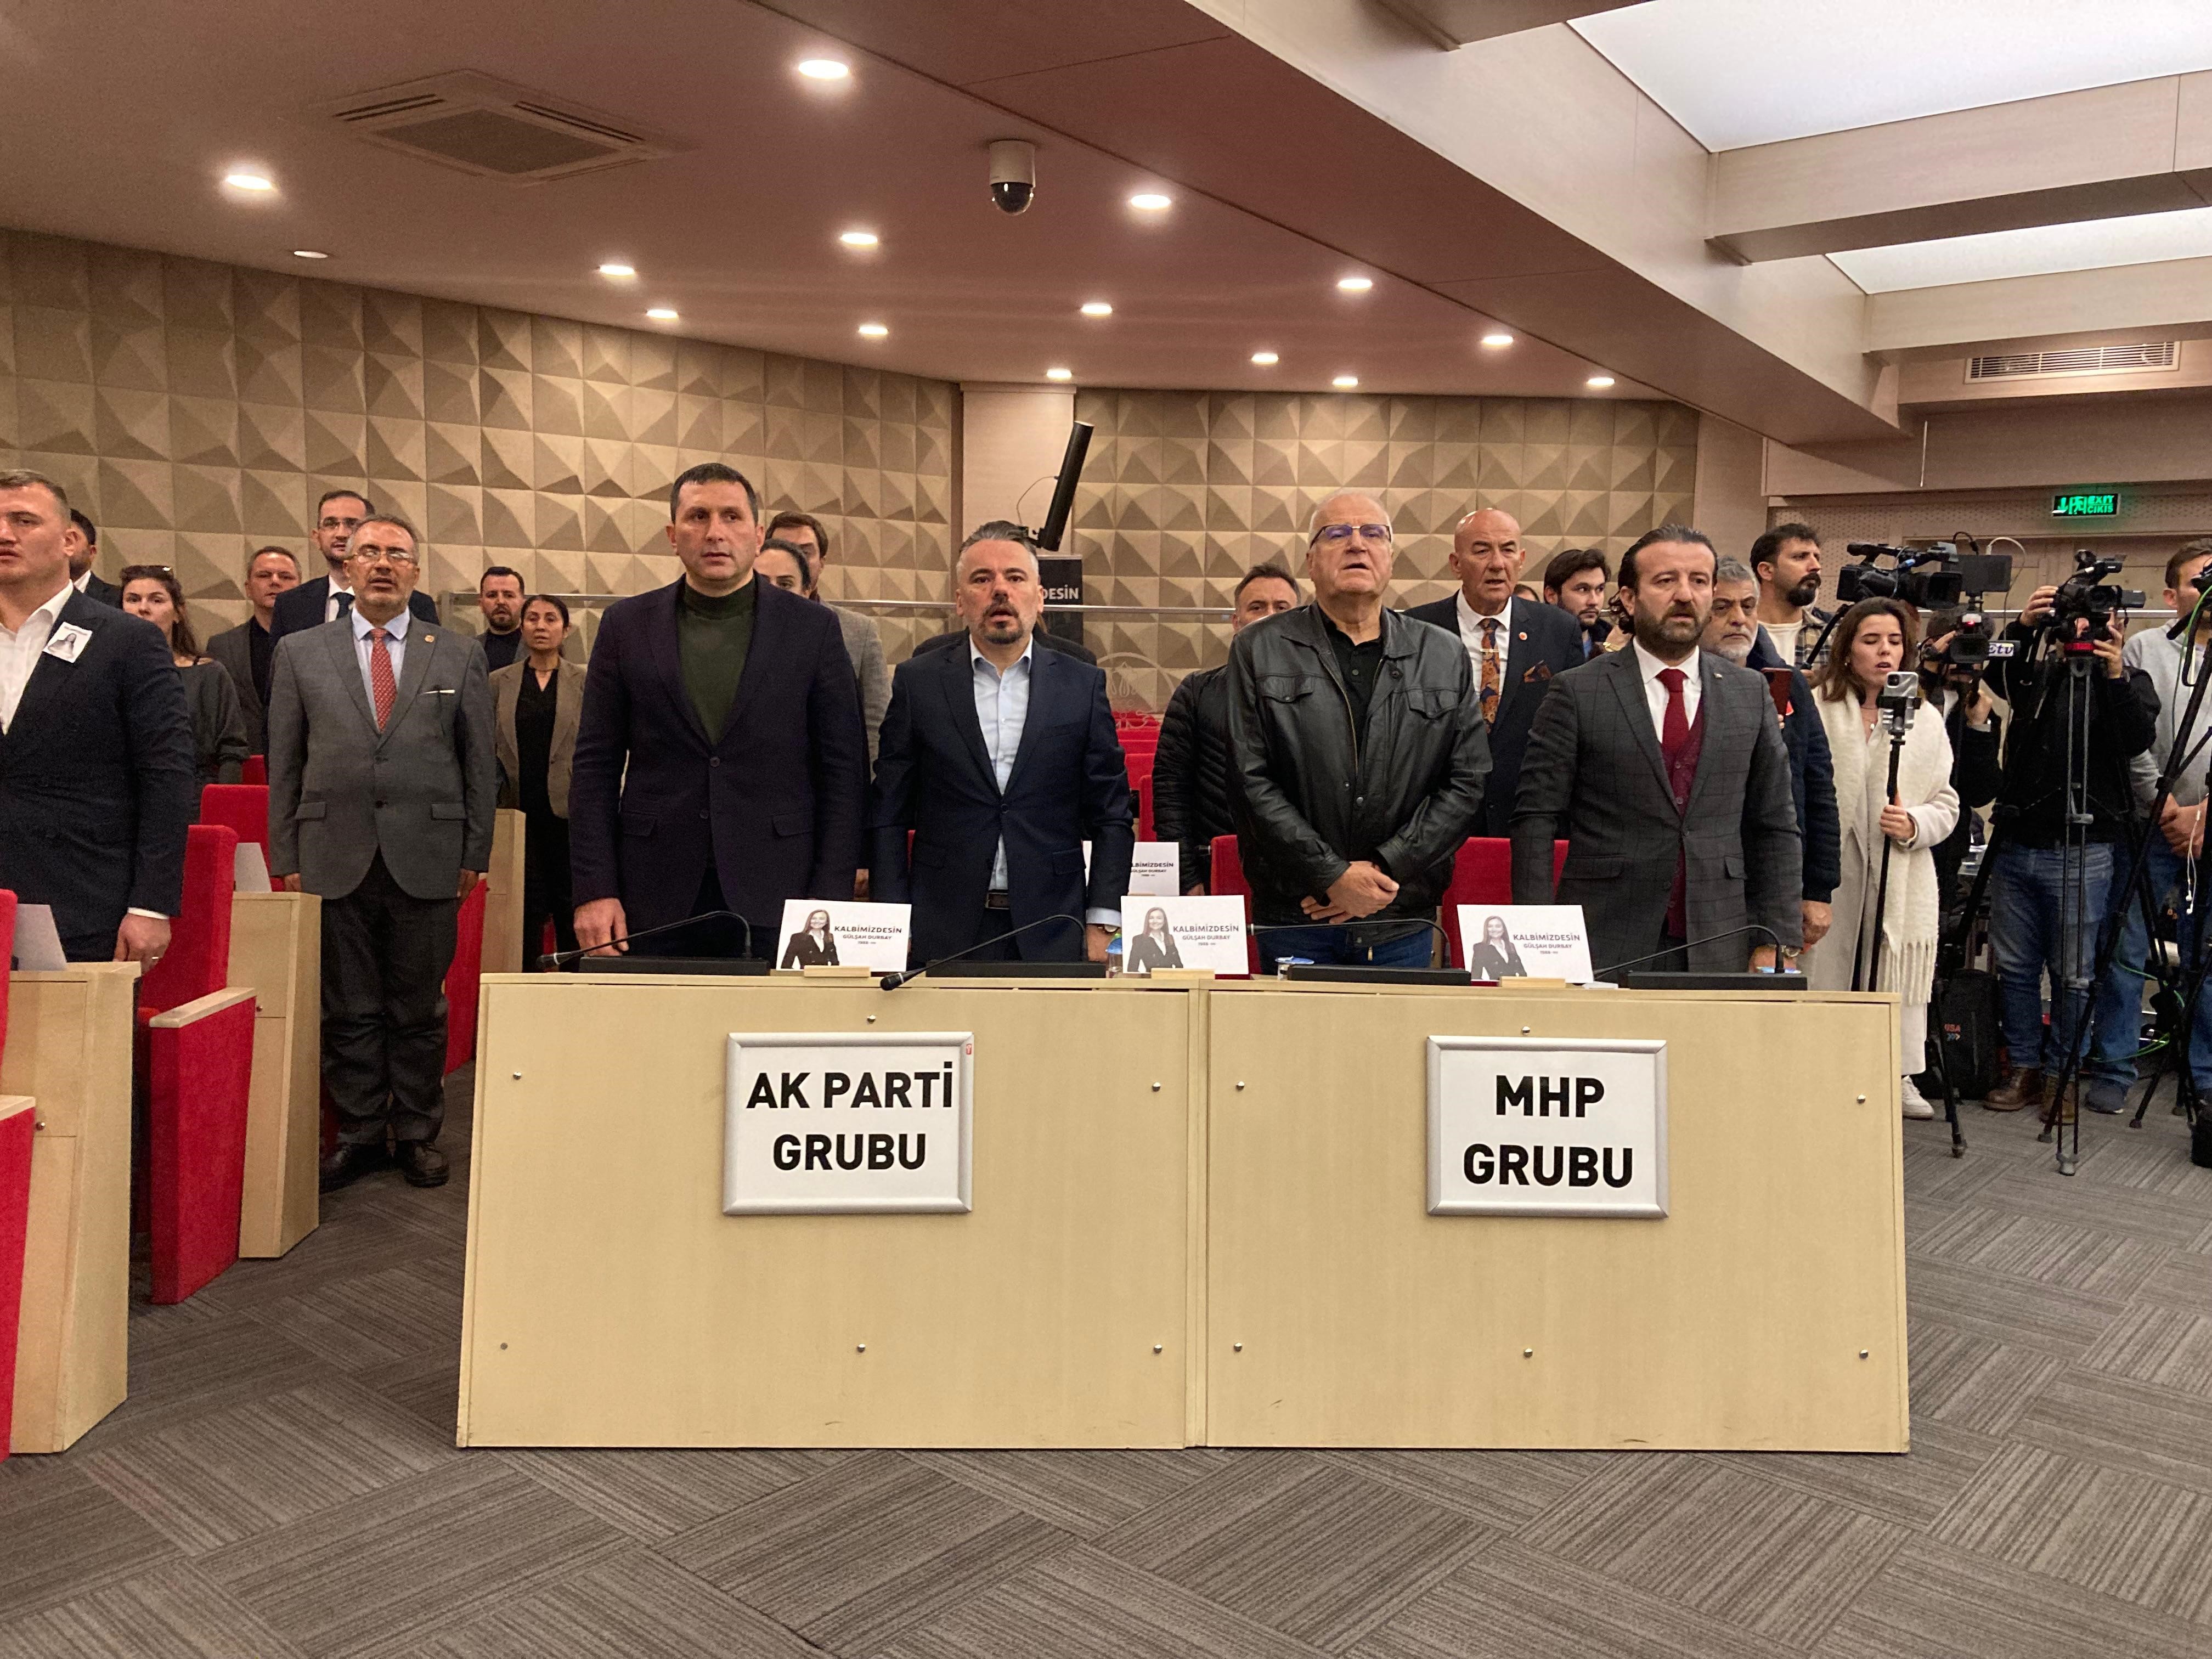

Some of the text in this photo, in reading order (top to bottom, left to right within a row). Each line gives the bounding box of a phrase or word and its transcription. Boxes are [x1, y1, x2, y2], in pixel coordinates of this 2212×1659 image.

[2088, 495, 2114, 504] EXIT
[834, 925, 902, 933] KALBİMİZDESİN
[1173, 923, 1239, 932] KALBİMİZDESİN
[1513, 933, 1580, 941] KALBİMİZDESİN
[746, 1061, 952, 1108] AK PARTİ
[1496, 1075, 1605, 1118] MHP
[773, 1133, 926, 1170] GRUBU
[1464, 1143, 1633, 1188] GRUBU
